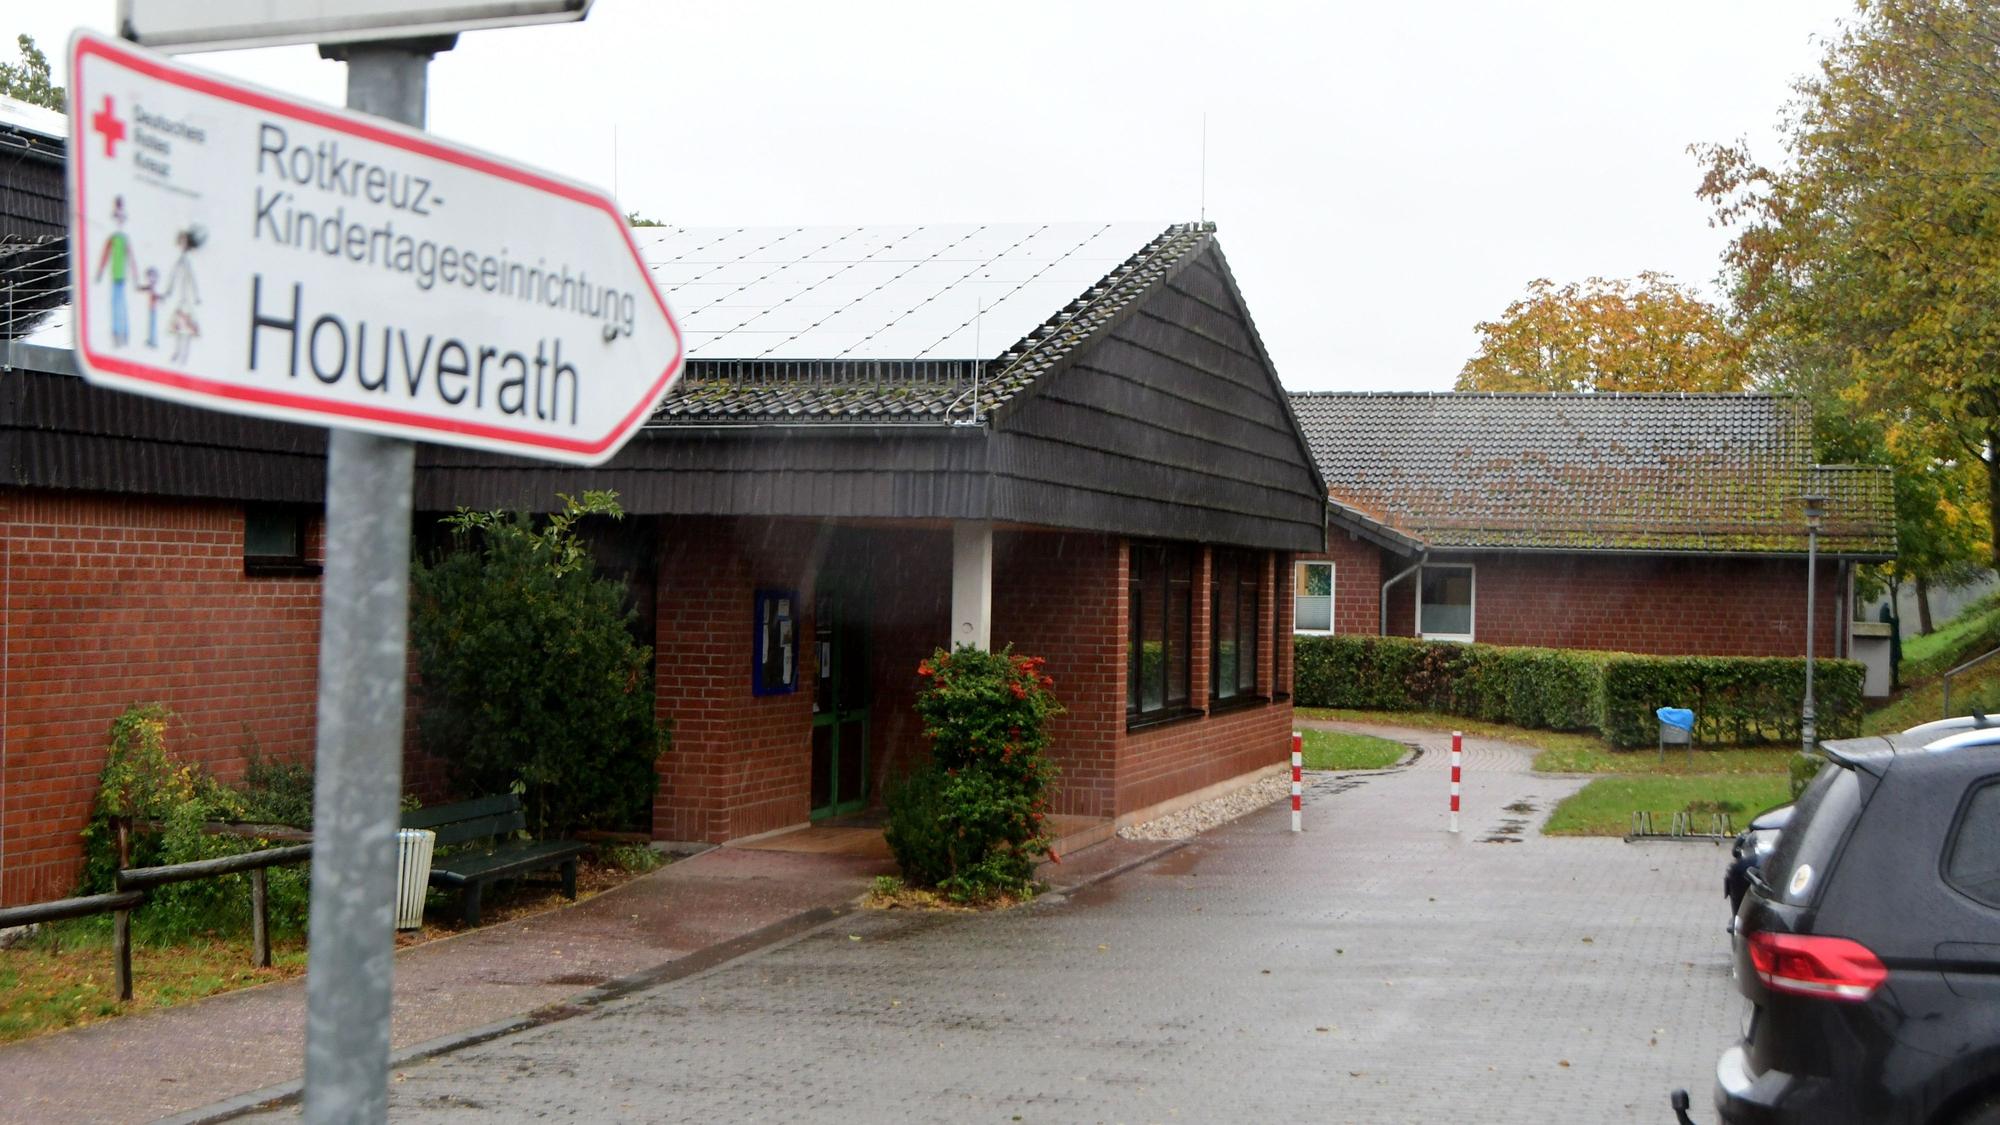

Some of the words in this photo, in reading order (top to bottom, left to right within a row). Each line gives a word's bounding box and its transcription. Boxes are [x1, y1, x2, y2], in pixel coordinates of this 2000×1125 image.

[257, 122, 445, 216] Rotkreuz-
[254, 187, 635, 337] Kindertageseinrichtung
[248, 274, 578, 425] Houverath
